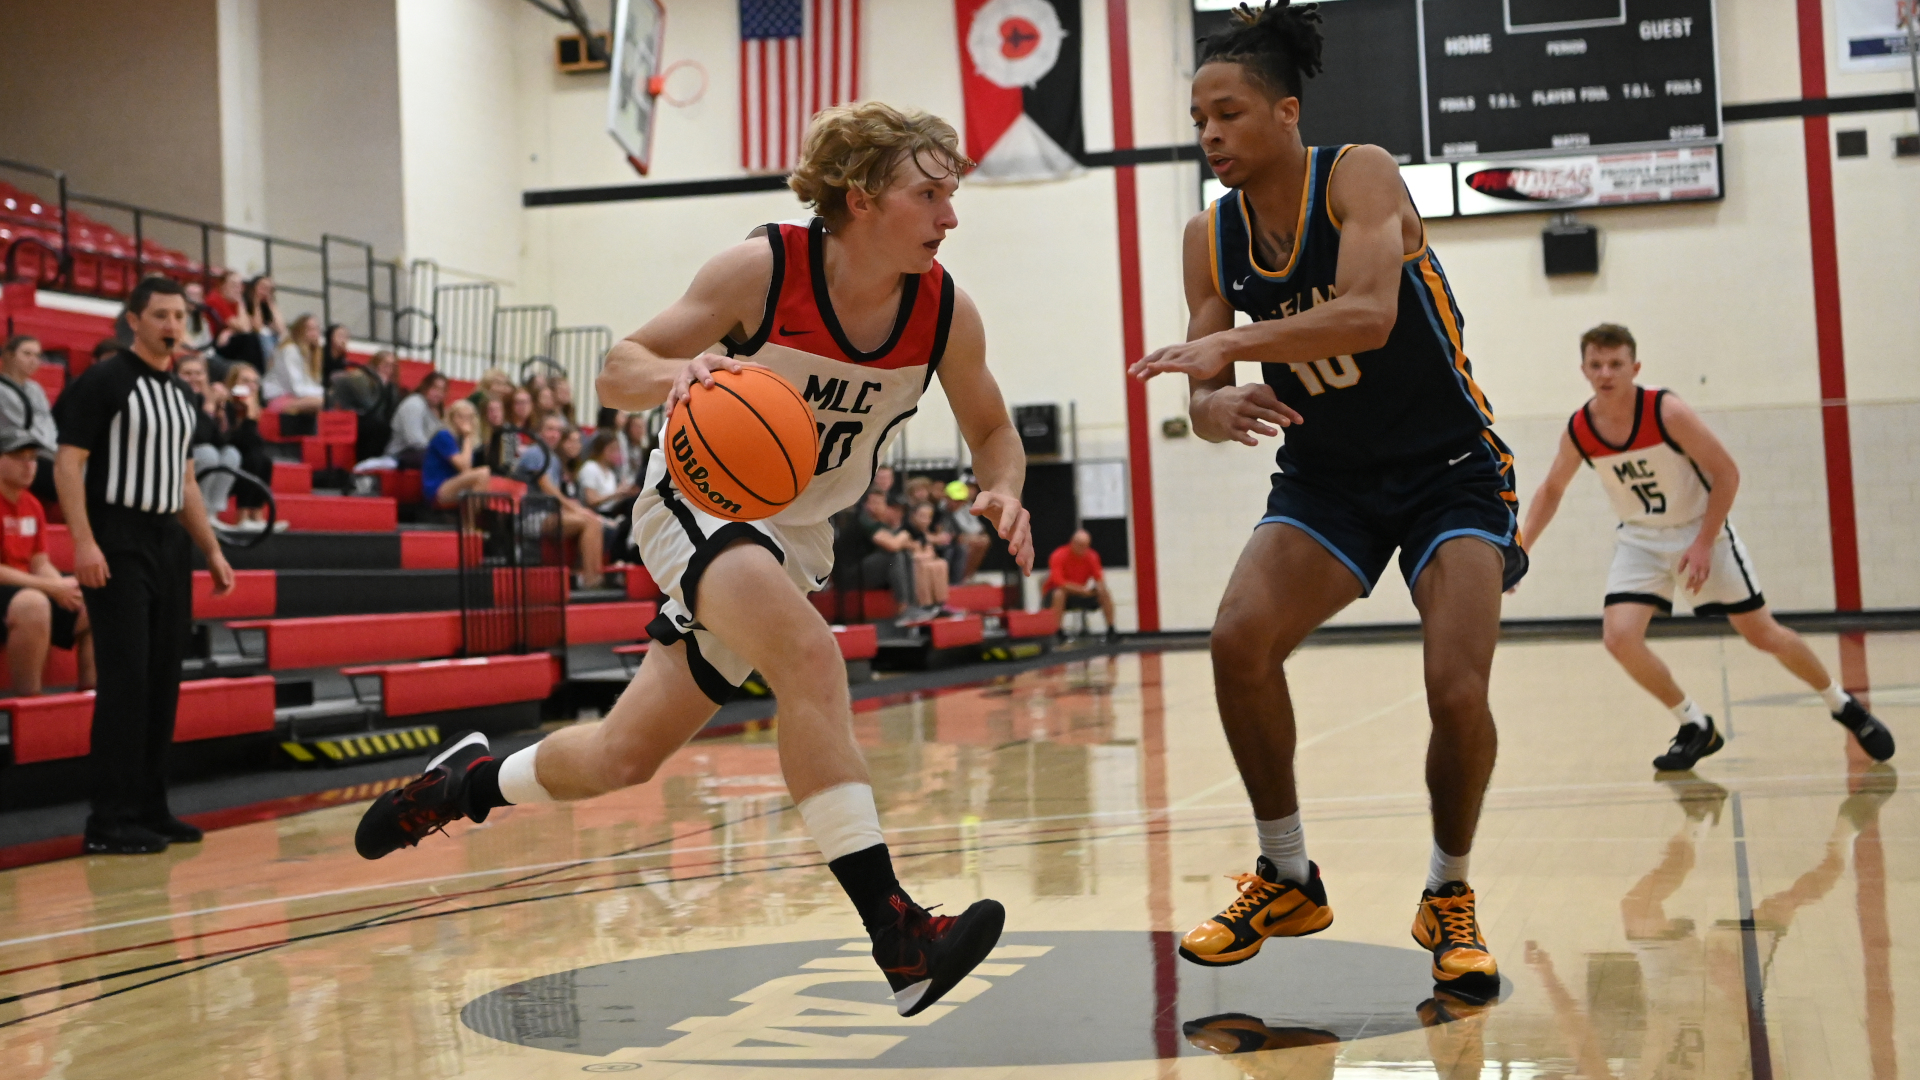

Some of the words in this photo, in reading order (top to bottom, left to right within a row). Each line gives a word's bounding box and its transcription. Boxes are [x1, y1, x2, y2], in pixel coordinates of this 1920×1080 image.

[1639, 17, 1692, 41] GUEST
[1444, 33, 1492, 56] HOME
[1545, 38, 1587, 56] PERIOD
[1532, 87, 1576, 106] PLAYER
[1665, 77, 1702, 96] FOULS
[1287, 354, 1362, 397] 10
[803, 374, 882, 414] MLC
[672, 424, 742, 514] Wilson
[1613, 459, 1655, 484] MLC
[1631, 482, 1667, 514] 15
